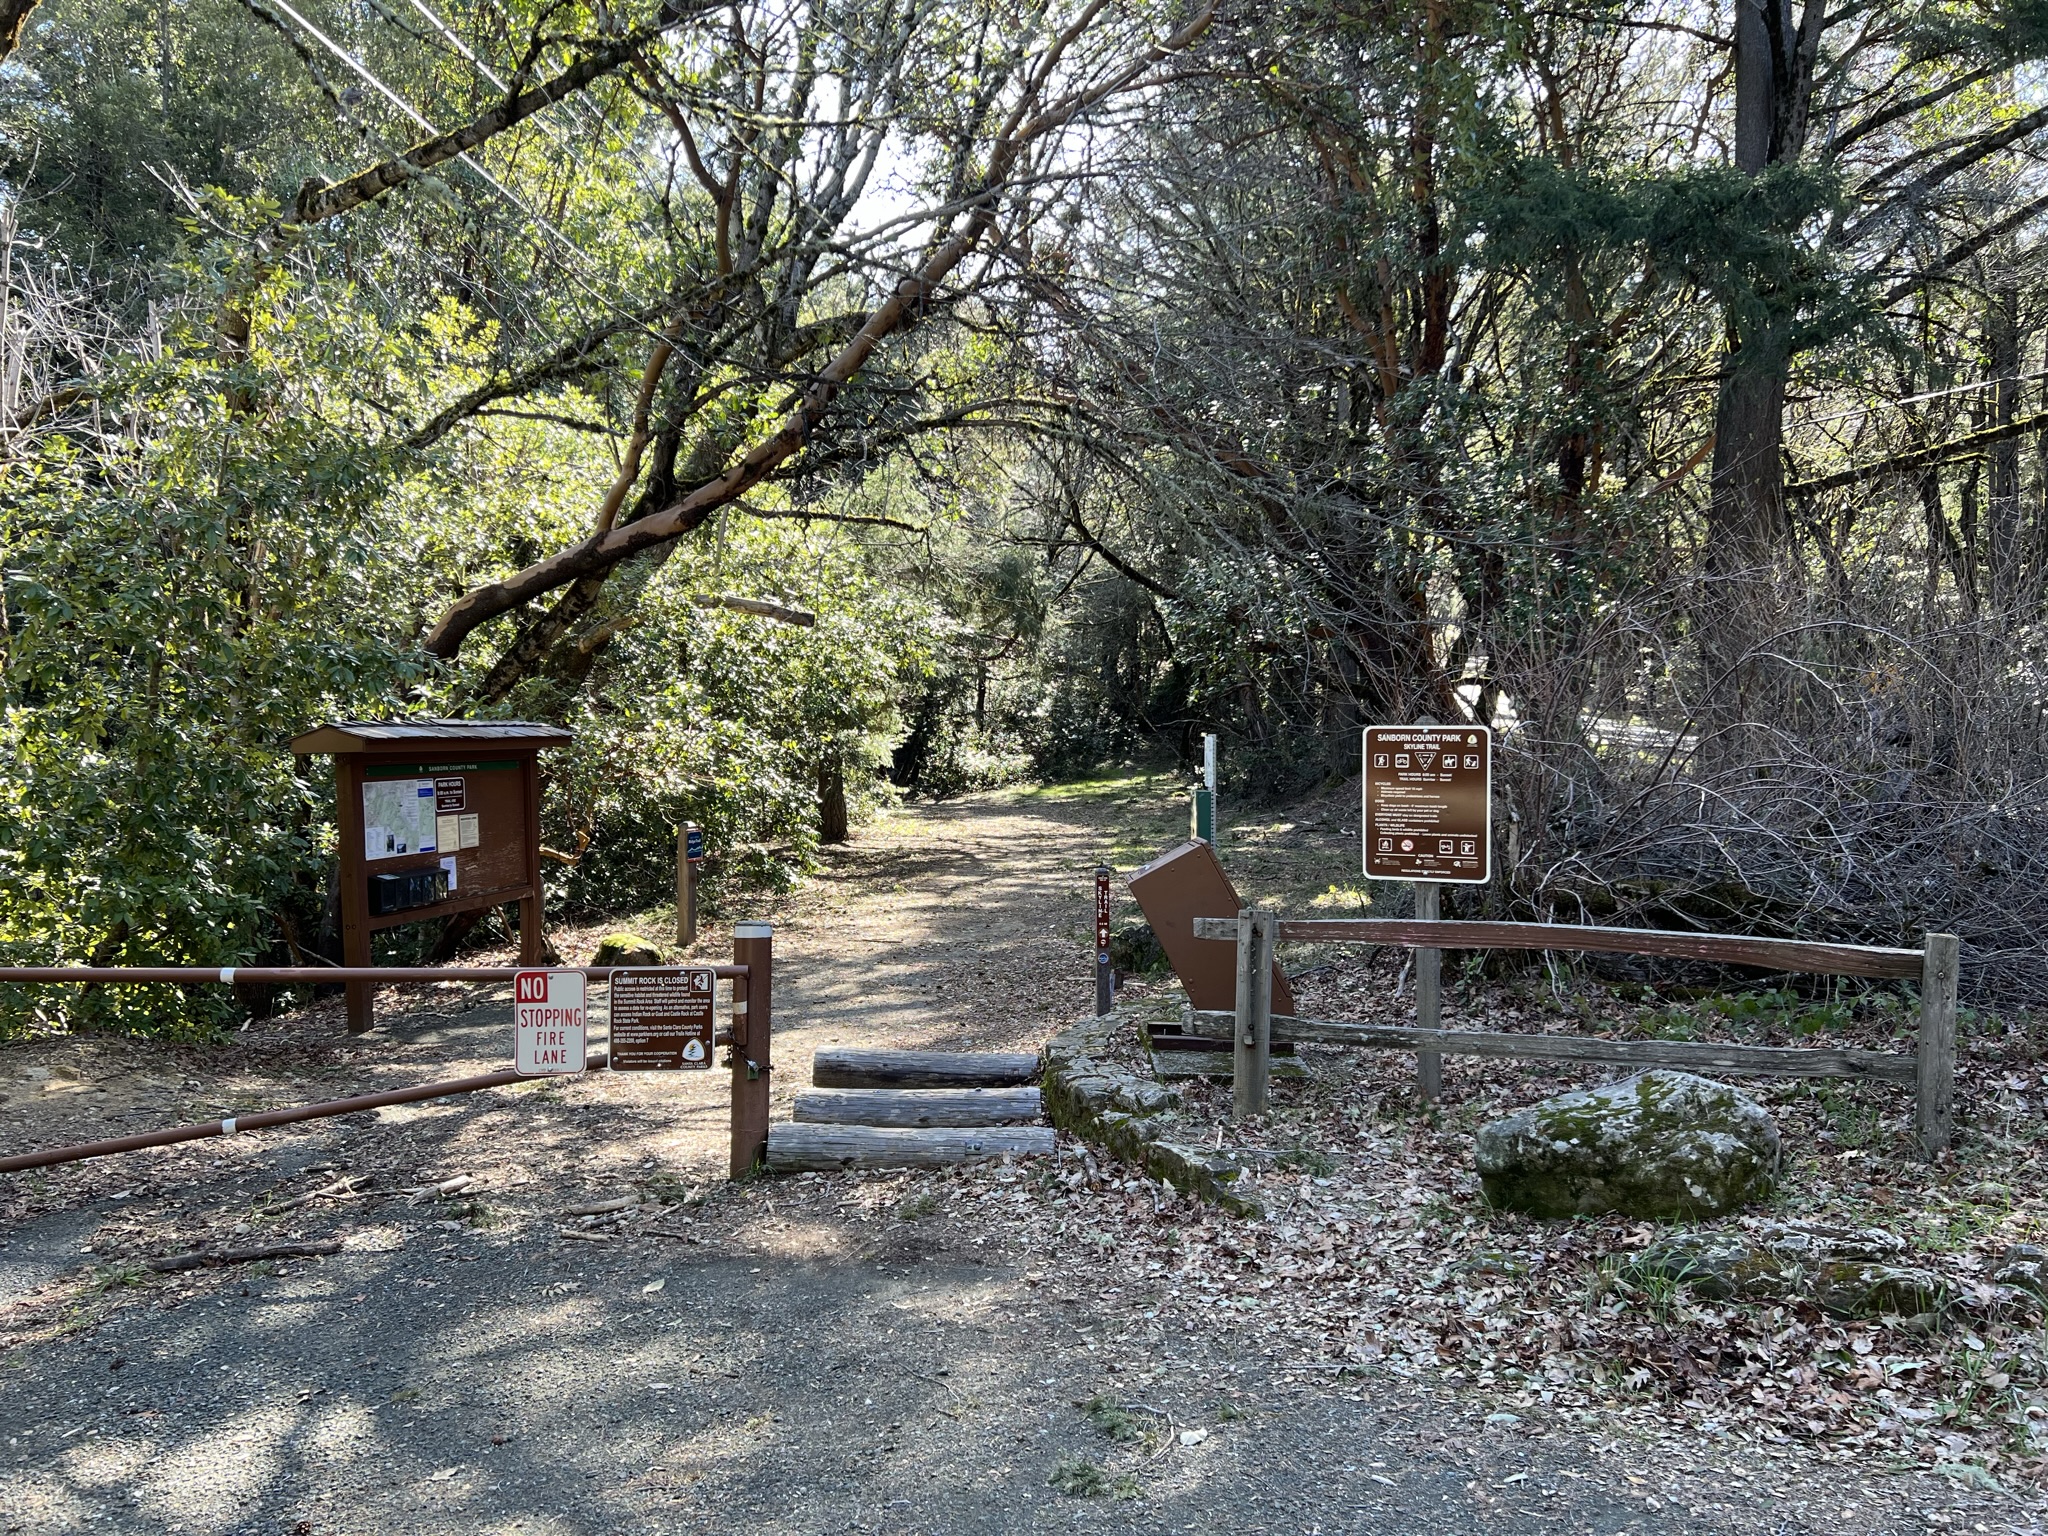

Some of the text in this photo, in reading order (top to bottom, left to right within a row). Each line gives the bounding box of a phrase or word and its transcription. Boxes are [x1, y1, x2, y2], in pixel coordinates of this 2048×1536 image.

[1377, 734, 1461, 742] SANBORN COUNTY PARK
[521, 977, 544, 999] NO
[521, 1008, 581, 1027] STOPPING
[537, 1032, 565, 1045] FIRE
[534, 1050, 566, 1064] LANE
